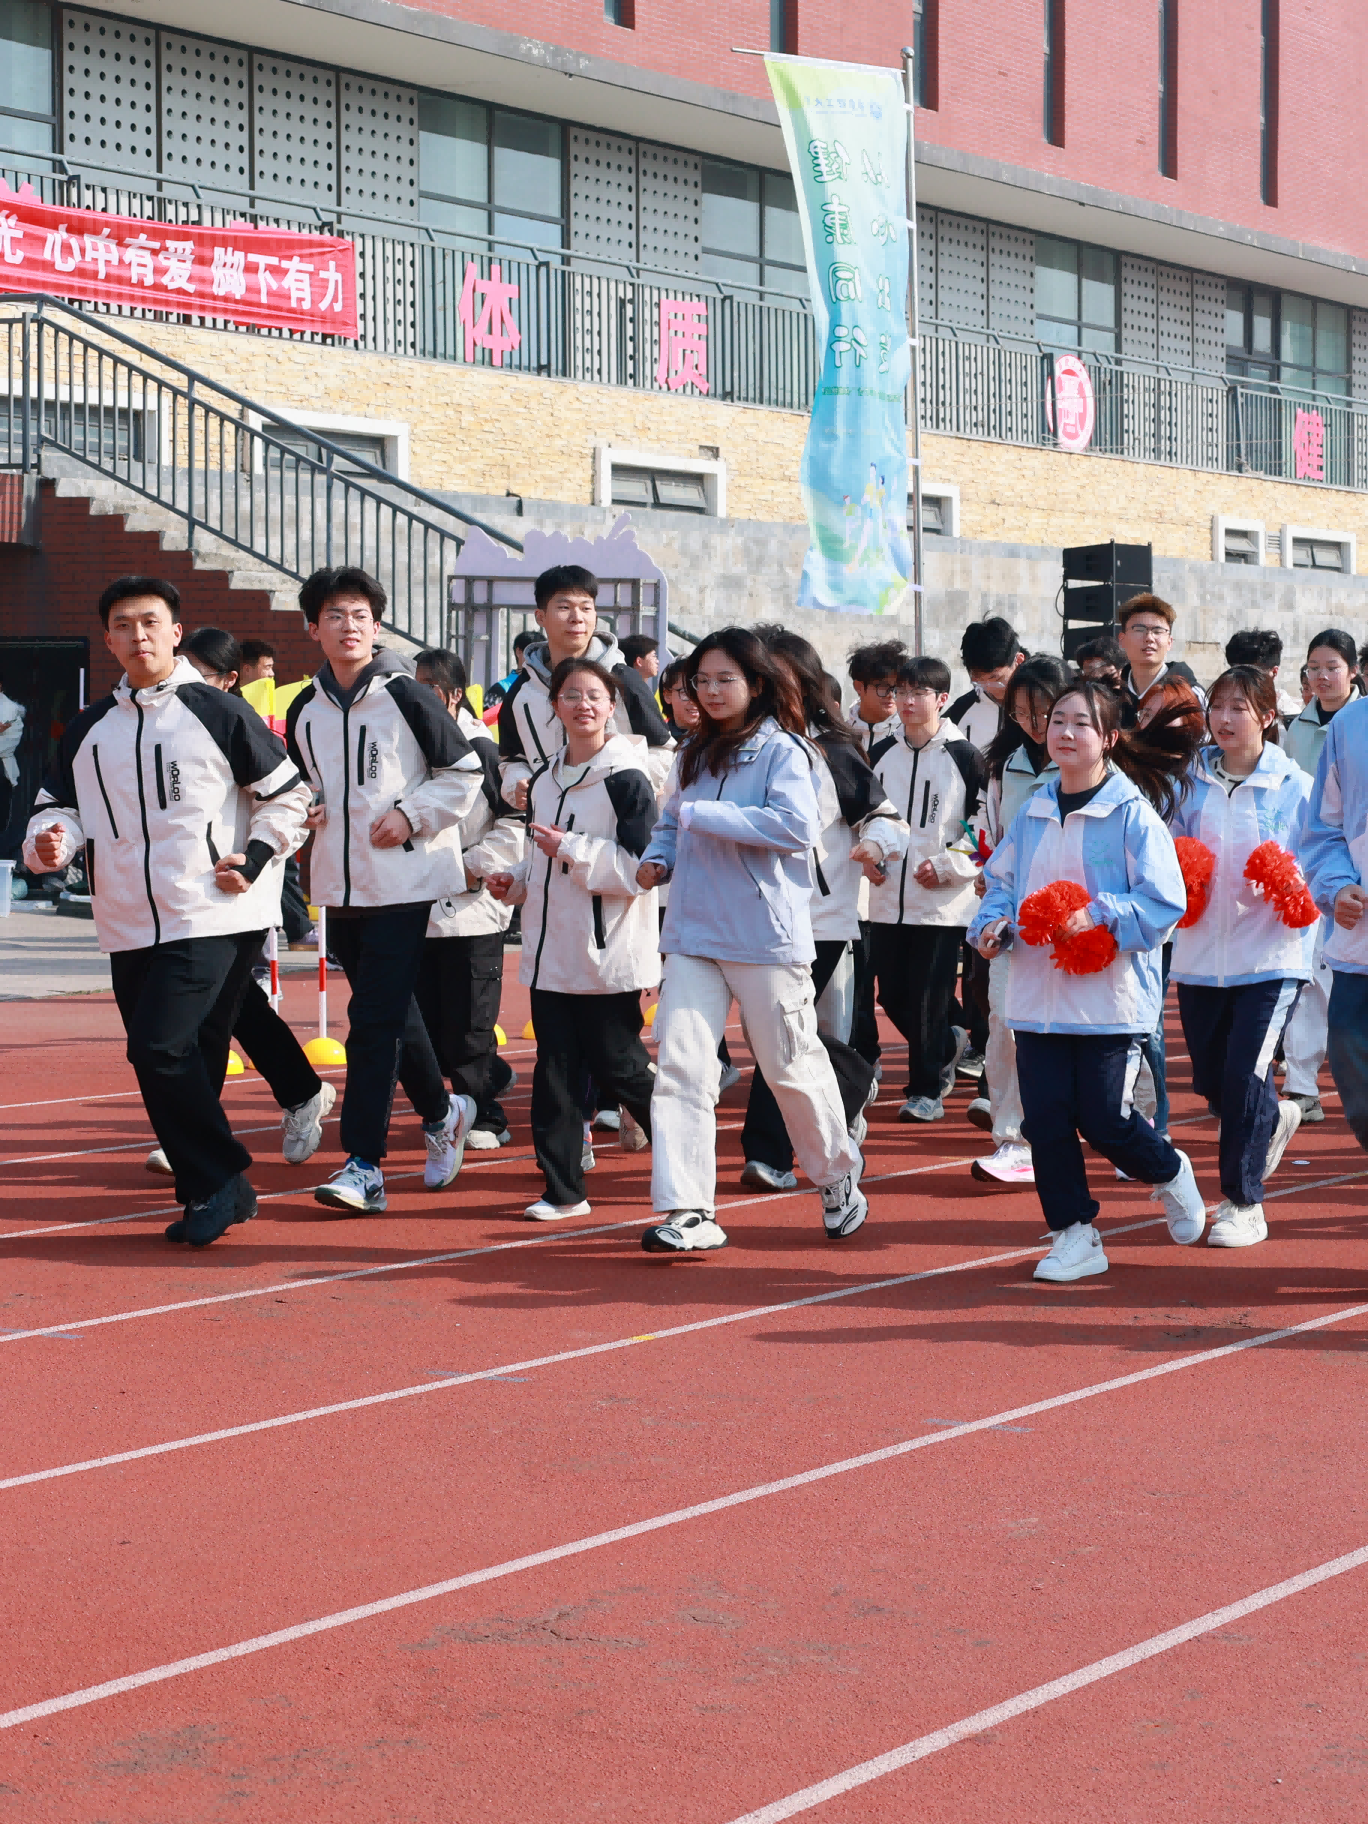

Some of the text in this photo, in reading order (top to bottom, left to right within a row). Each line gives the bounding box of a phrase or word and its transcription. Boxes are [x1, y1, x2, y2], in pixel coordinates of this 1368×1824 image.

[43, 223, 197, 294] 心中有爱
[210, 246, 343, 313] 脚下有力
